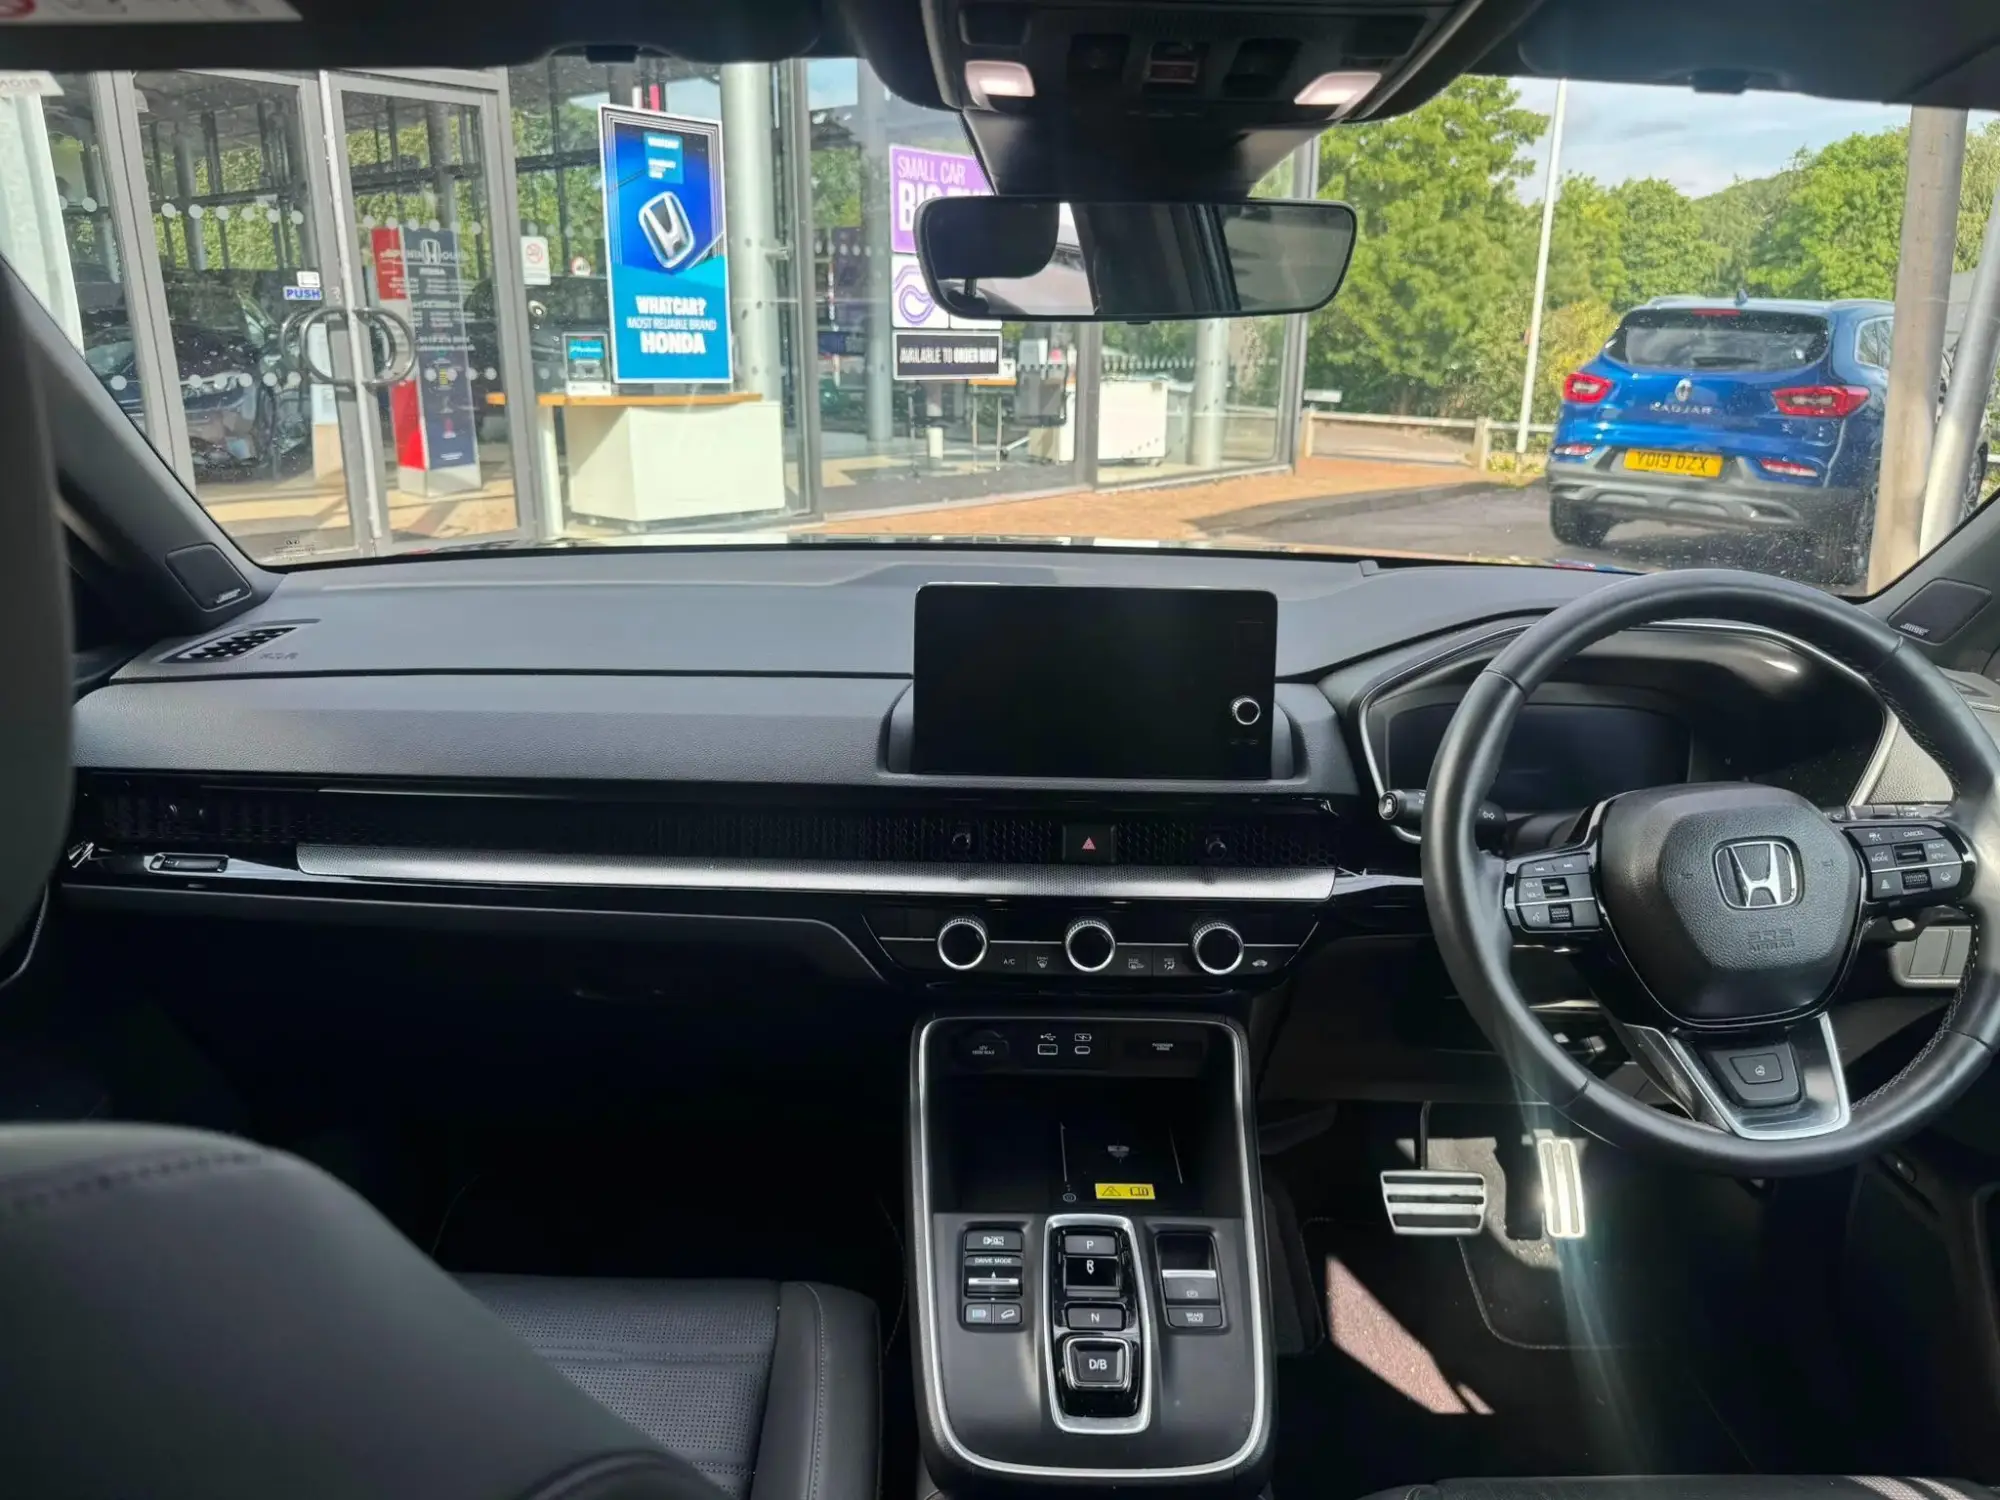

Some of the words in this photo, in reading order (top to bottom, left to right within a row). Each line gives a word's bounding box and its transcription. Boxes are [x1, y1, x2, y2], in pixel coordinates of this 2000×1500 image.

[898, 156, 937, 182] SMALL
[940, 161, 966, 185] CAR
[287, 288, 321, 298] PUSH
[626, 316, 652, 328] MOST
[653, 317, 688, 330] RELIABLE
[689, 318, 717, 331] BRAND
[640, 331, 706, 353] HONDA
[899, 346, 942, 363] AVAILABLE
[942, 346, 953, 363] TO
[1003, 958, 1016, 966] A/C
[1086, 1240, 1094, 1250] P
[1091, 1313, 1099, 1323] N
[1089, 1359, 1107, 1370] D/B
